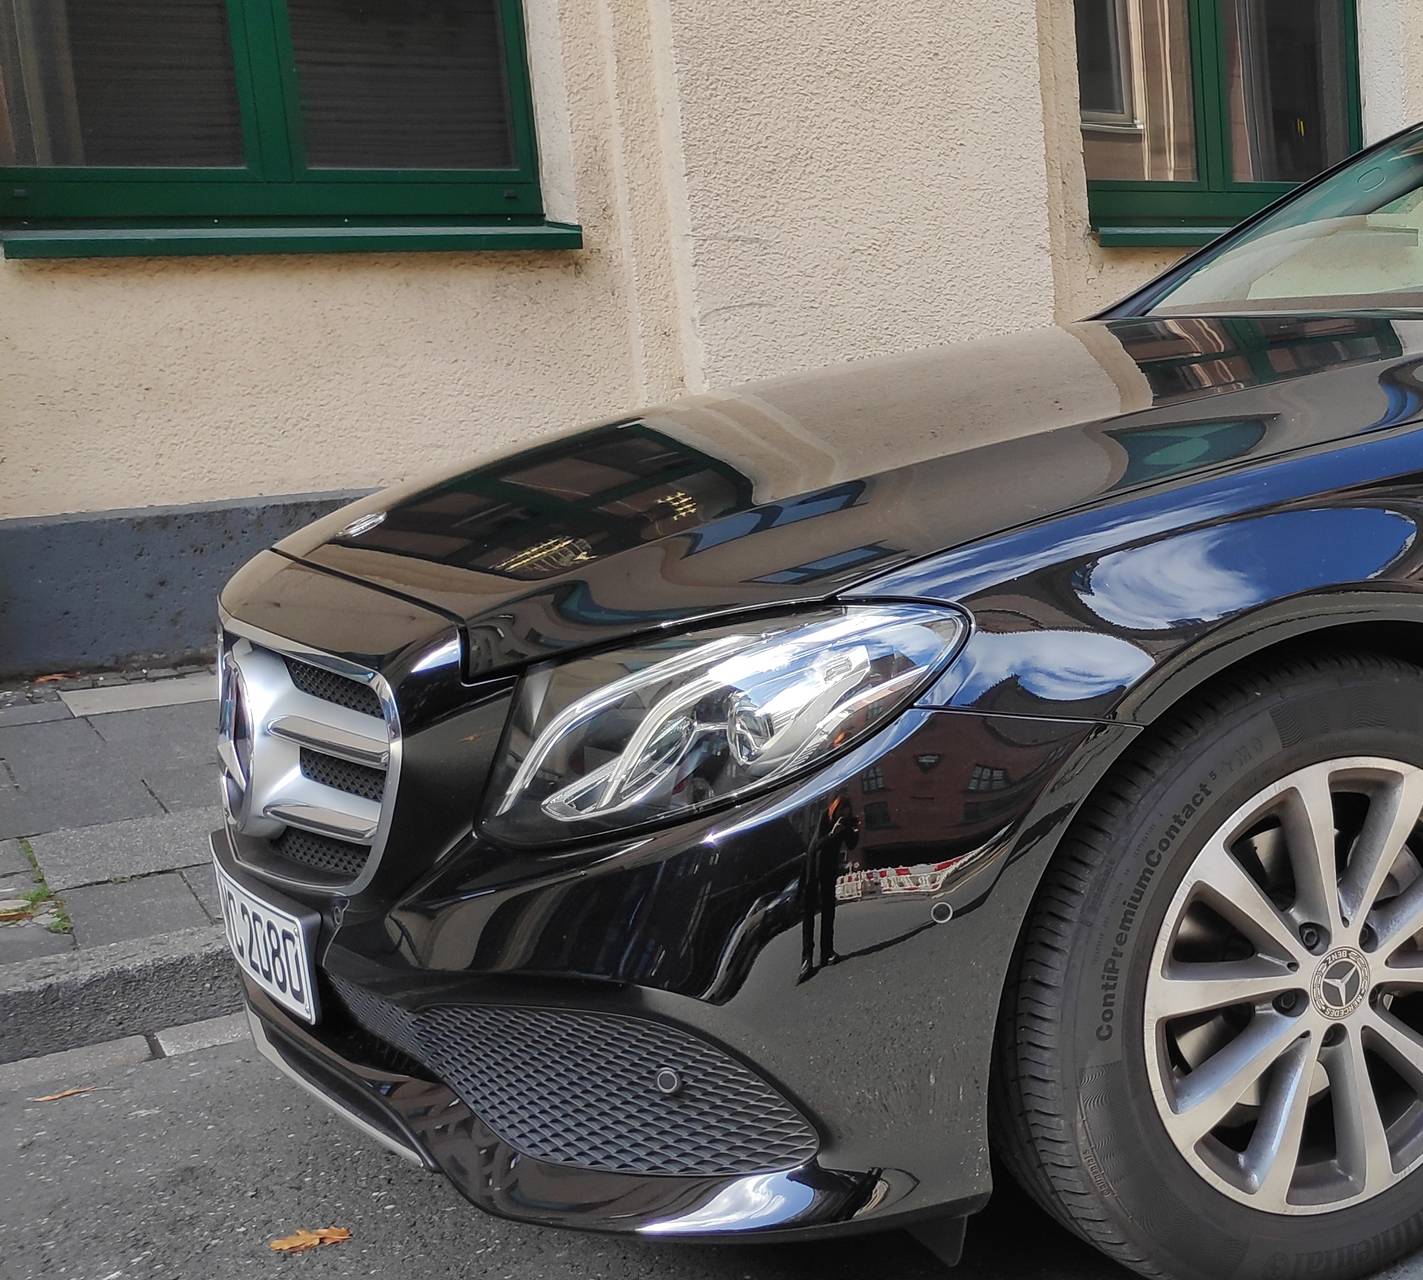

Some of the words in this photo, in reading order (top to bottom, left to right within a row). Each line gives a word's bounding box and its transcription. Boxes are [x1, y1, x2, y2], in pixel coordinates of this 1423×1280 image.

[1096, 782, 1212, 1041] ContiPremiumContact
[241, 902, 305, 1004] 2080
[1326, 950, 1348, 964] BENZ
[1325, 994, 1363, 1017] MERCEDES
